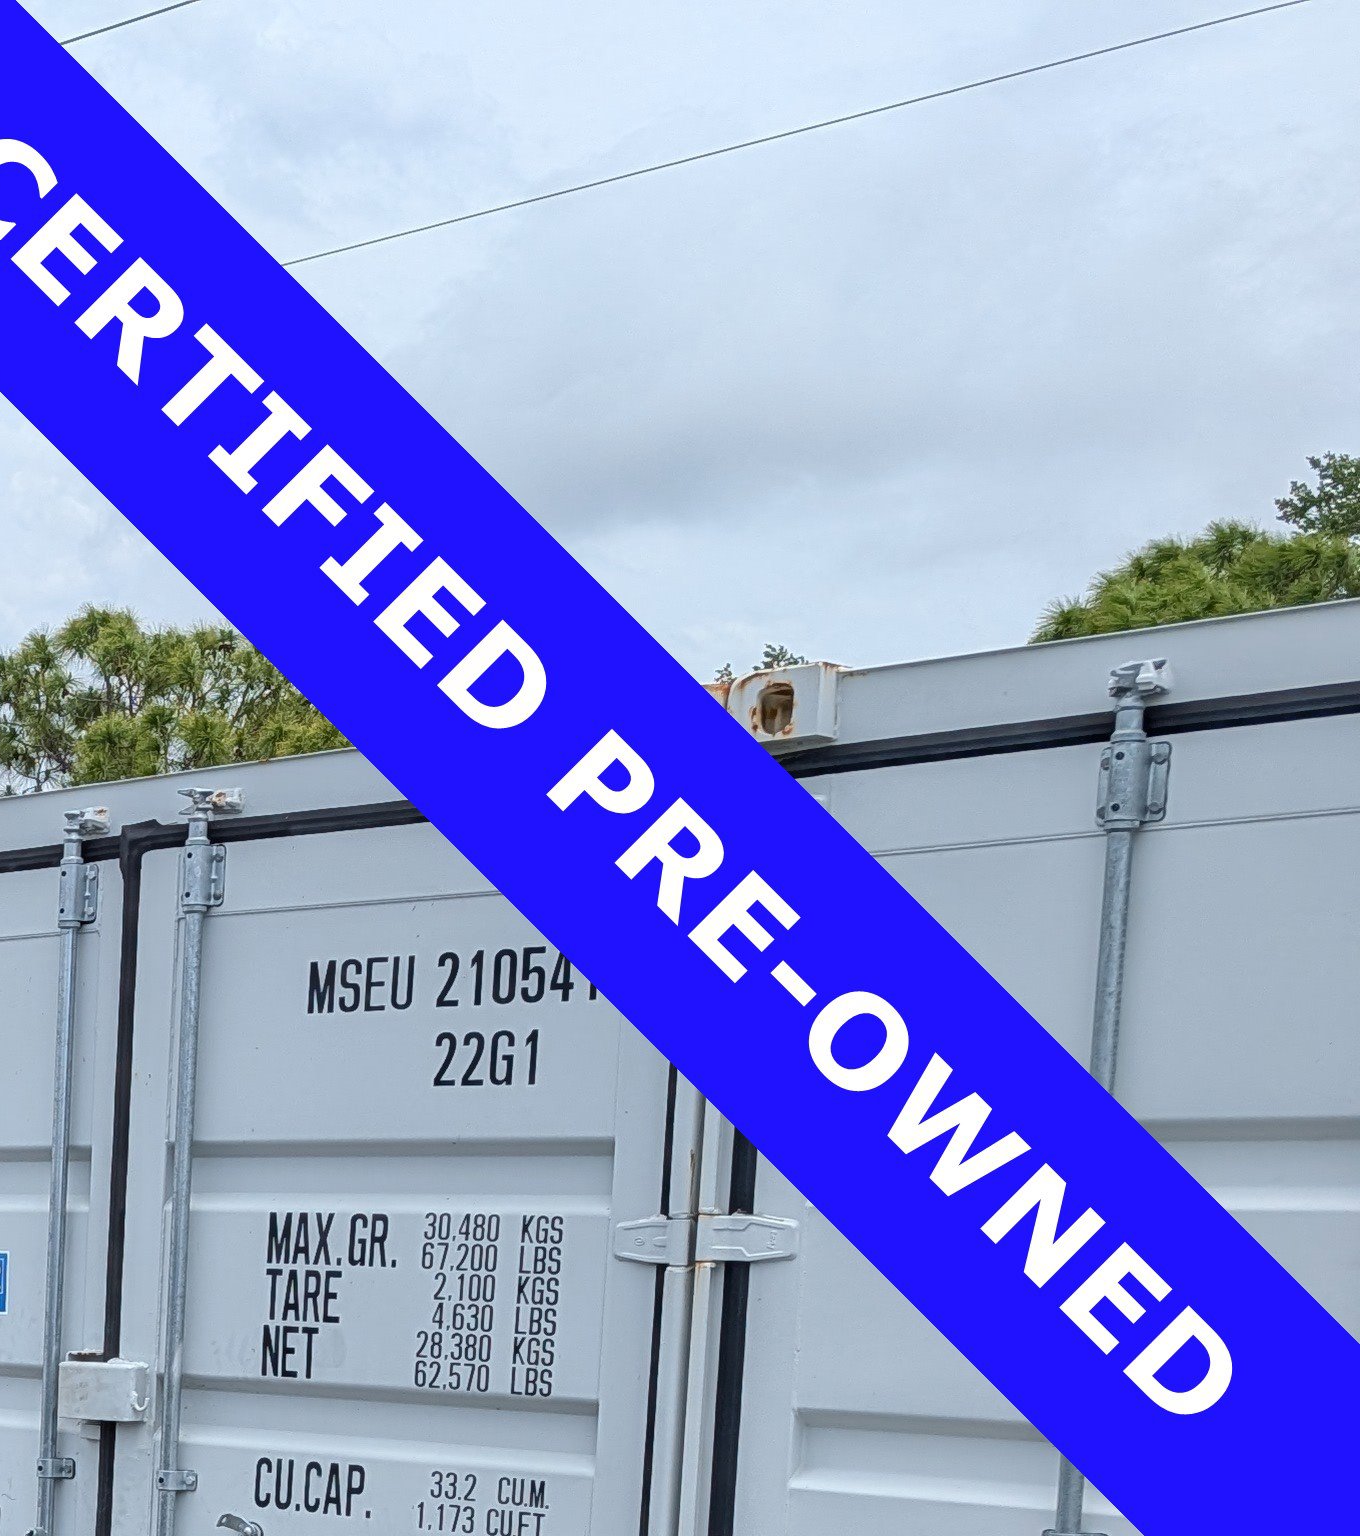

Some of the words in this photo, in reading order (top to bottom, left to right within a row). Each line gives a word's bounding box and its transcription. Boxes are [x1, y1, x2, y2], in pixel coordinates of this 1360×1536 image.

[307, 954, 416, 1015] MSEU
[433, 1028, 540, 1087] 22G1
[423, 1212, 501, 1243] 30,480
[520, 1214, 564, 1244] KGS
[421, 1242, 498, 1273] 67,200
[518, 1245, 562, 1276] LBS
[266, 1268, 343, 1324] TARE
[433, 1273, 496, 1303] 2,100
[516, 1276, 560, 1306] KGS
[431, 1303, 494, 1333] 4,630
[514, 1306, 557, 1336] LBS
[261, 1324, 319, 1380] NET
[415, 1331, 492, 1363] 28,380
[511, 1336, 555, 1367] KGS
[414, 1360, 490, 1393] 62,570
[510, 1367, 553, 1398] LBS
[430, 1470, 478, 1502] 33.2
[497, 1476, 550, 1510] CU.M.
[416, 1501, 475, 1534] 1,173
